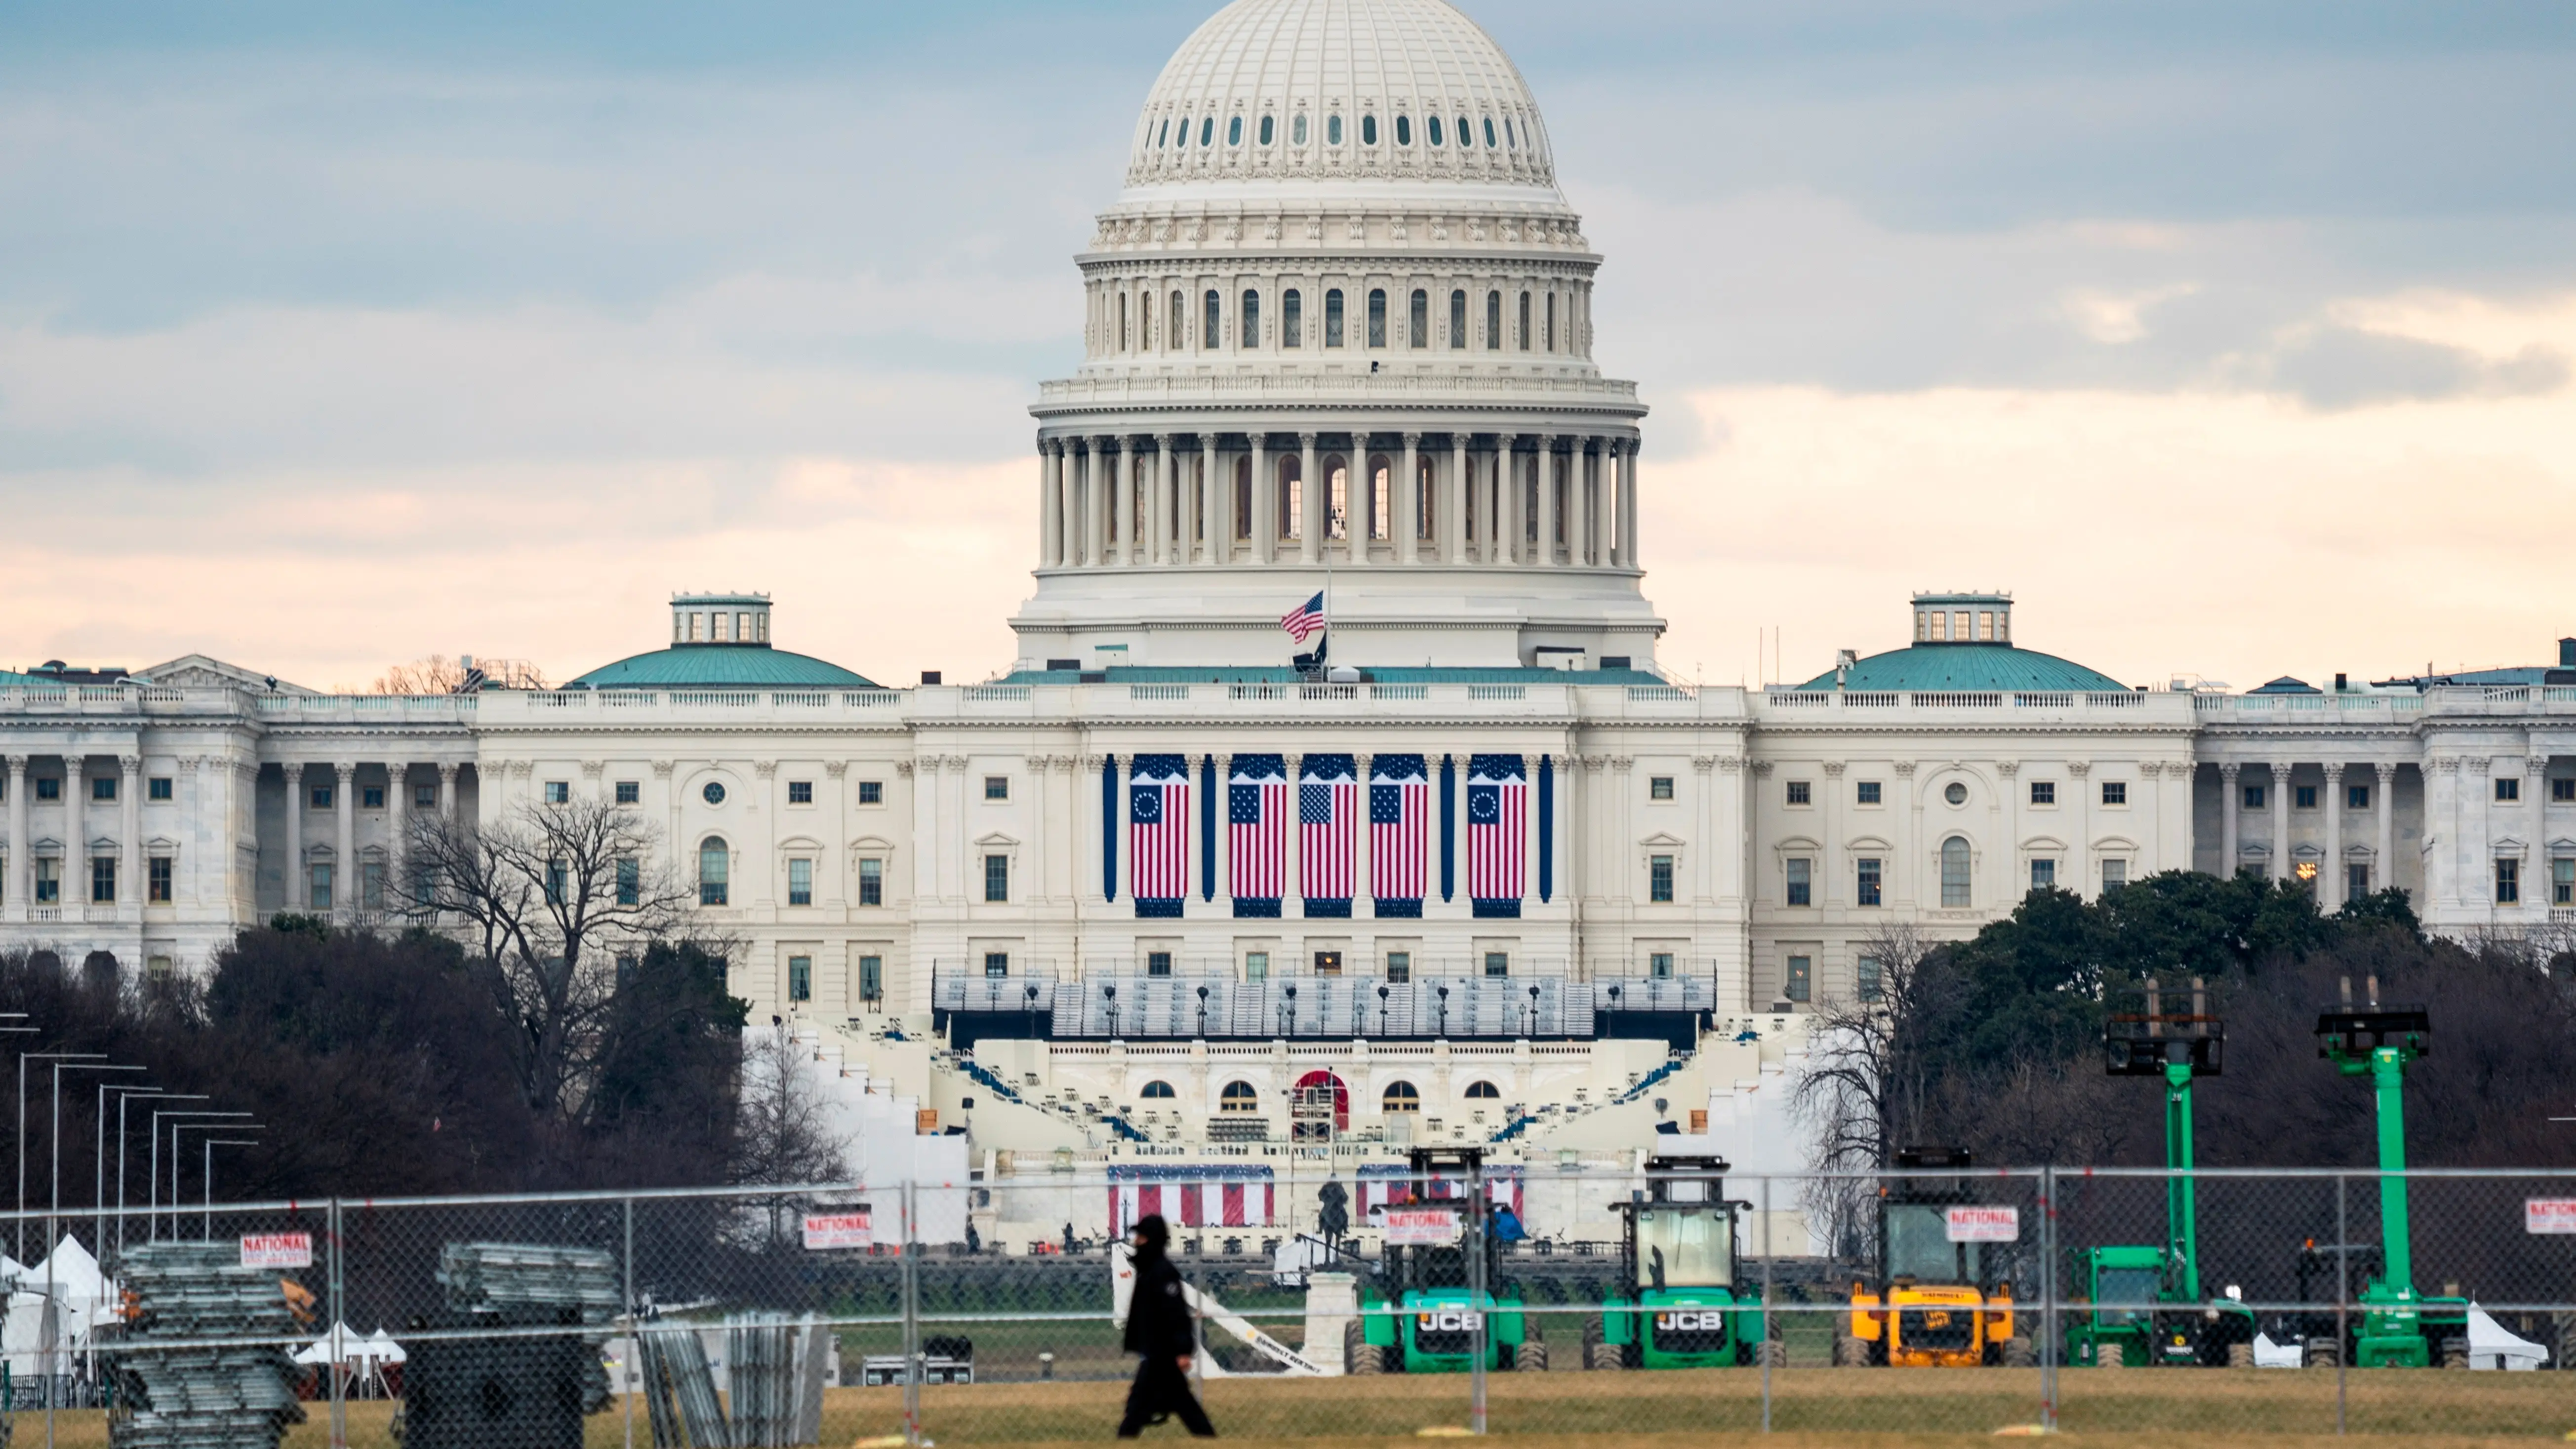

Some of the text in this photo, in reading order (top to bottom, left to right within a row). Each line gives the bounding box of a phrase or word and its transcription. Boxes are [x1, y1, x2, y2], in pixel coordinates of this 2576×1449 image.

[806, 1215, 870, 1231] NATIONAL
[1389, 1212, 1452, 1227] NATIONAL
[1952, 1211, 2013, 1225] NATIONAL
[244, 1234, 308, 1251] NATIONAL
[1419, 1312, 1482, 1331] JCB
[1658, 1312, 1722, 1330] JCB
